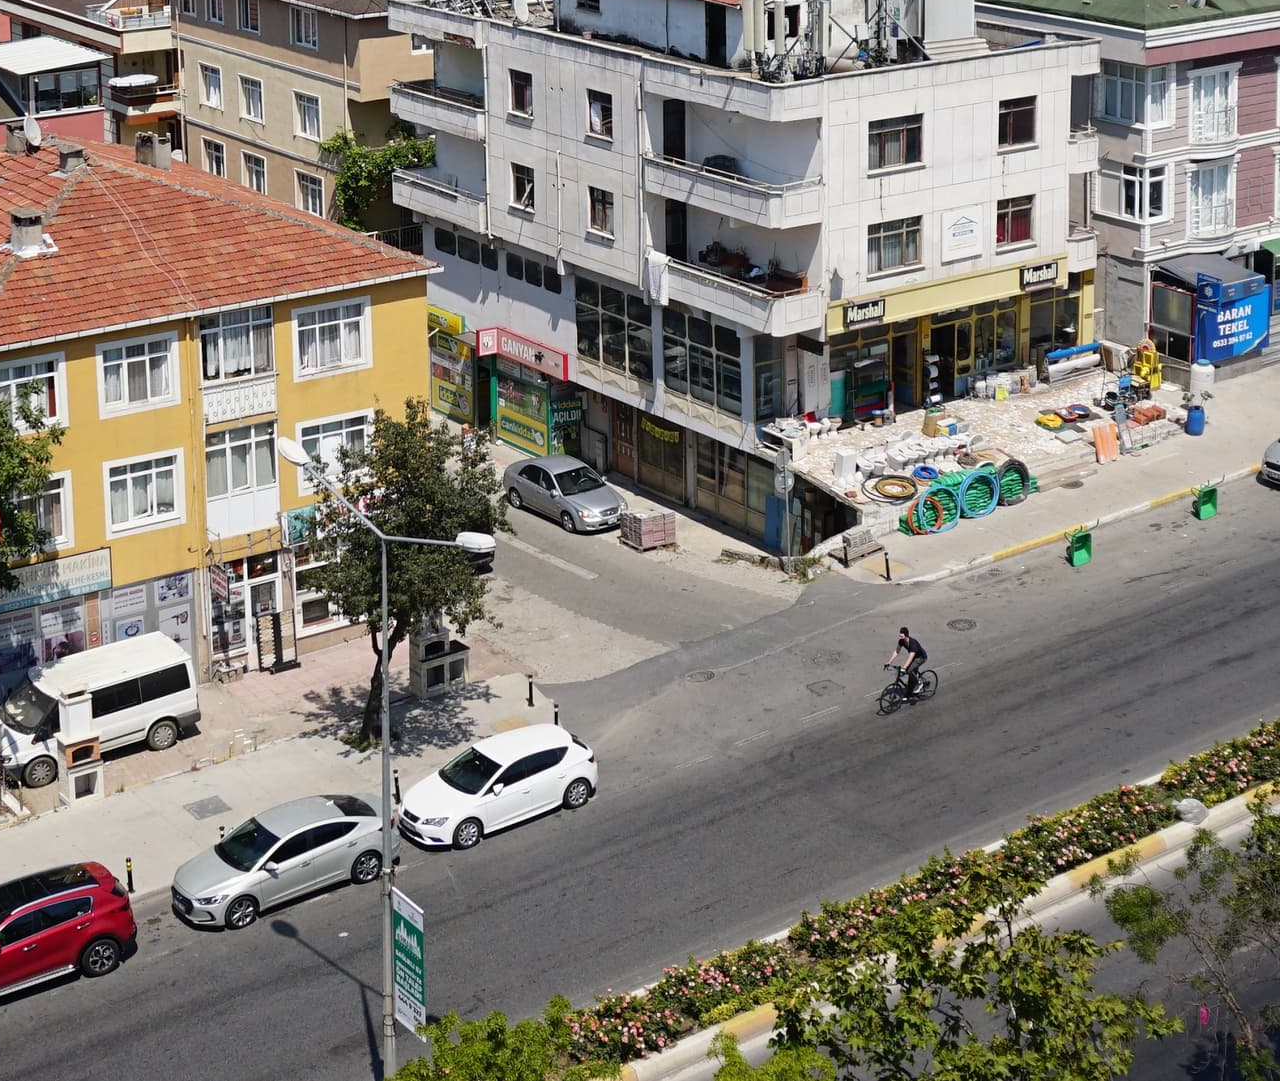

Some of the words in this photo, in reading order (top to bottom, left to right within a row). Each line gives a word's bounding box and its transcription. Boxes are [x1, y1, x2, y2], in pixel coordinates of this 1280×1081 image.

[1023, 262, 1058, 286] Marshall
[847, 300, 884, 324] Marshall
[1217, 304, 1252, 323] BARAN
[1218, 320, 1249, 336] TEKEL
[501, 336, 536, 363] GANYAN
